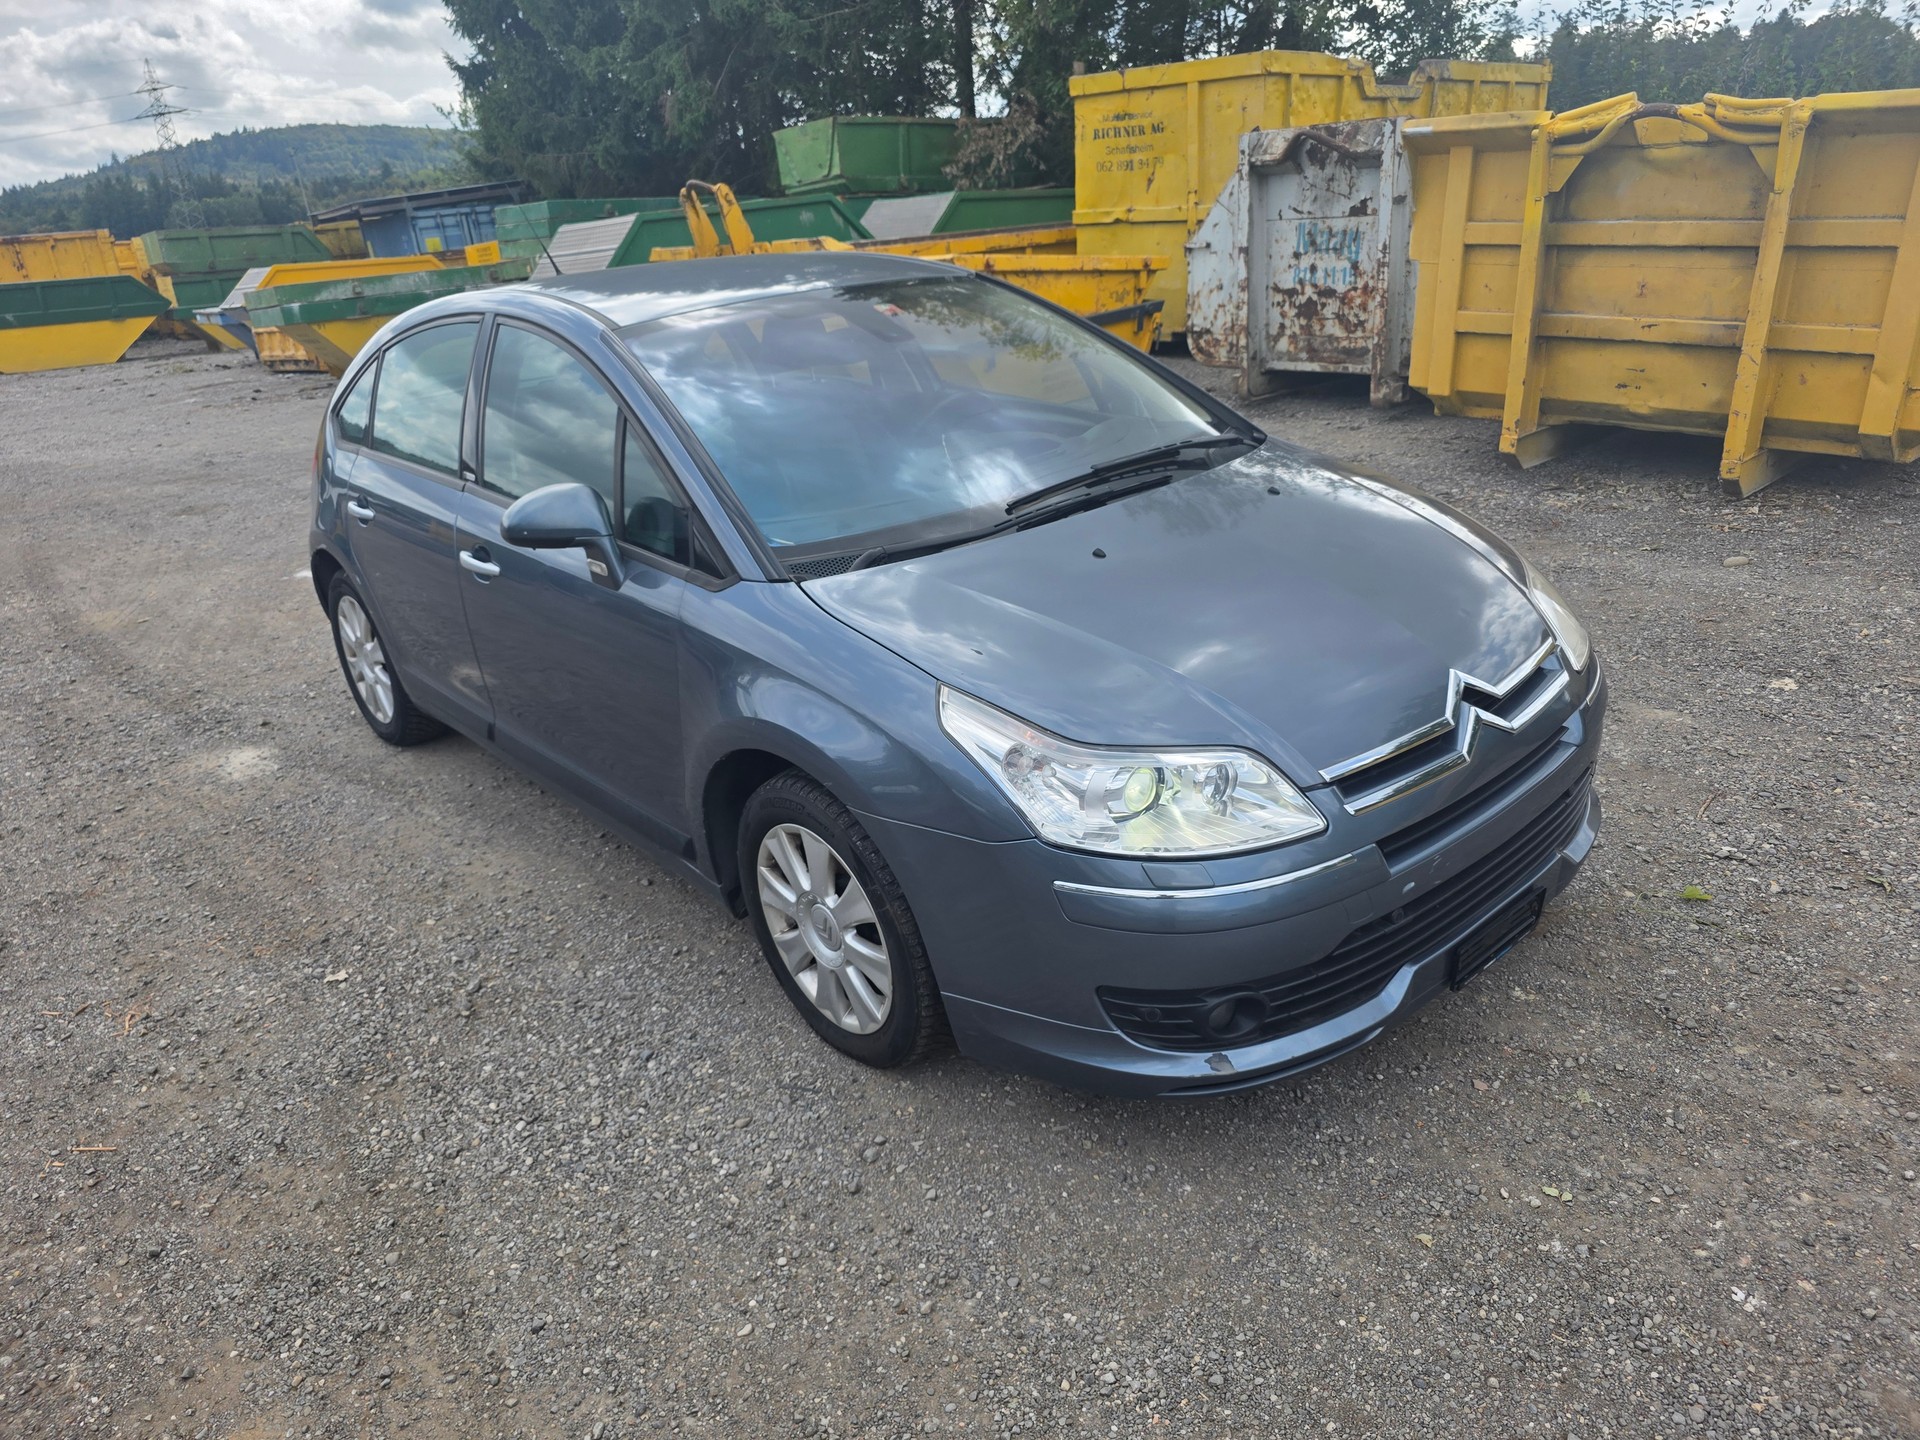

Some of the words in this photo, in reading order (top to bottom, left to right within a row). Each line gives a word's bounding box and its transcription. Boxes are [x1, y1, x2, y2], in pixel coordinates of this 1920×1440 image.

[1093, 125, 1146, 140] RICHNER
[1151, 121, 1164, 134] AG
[1096, 161, 1114, 173] 062
[1117, 159, 1134, 171] 891
